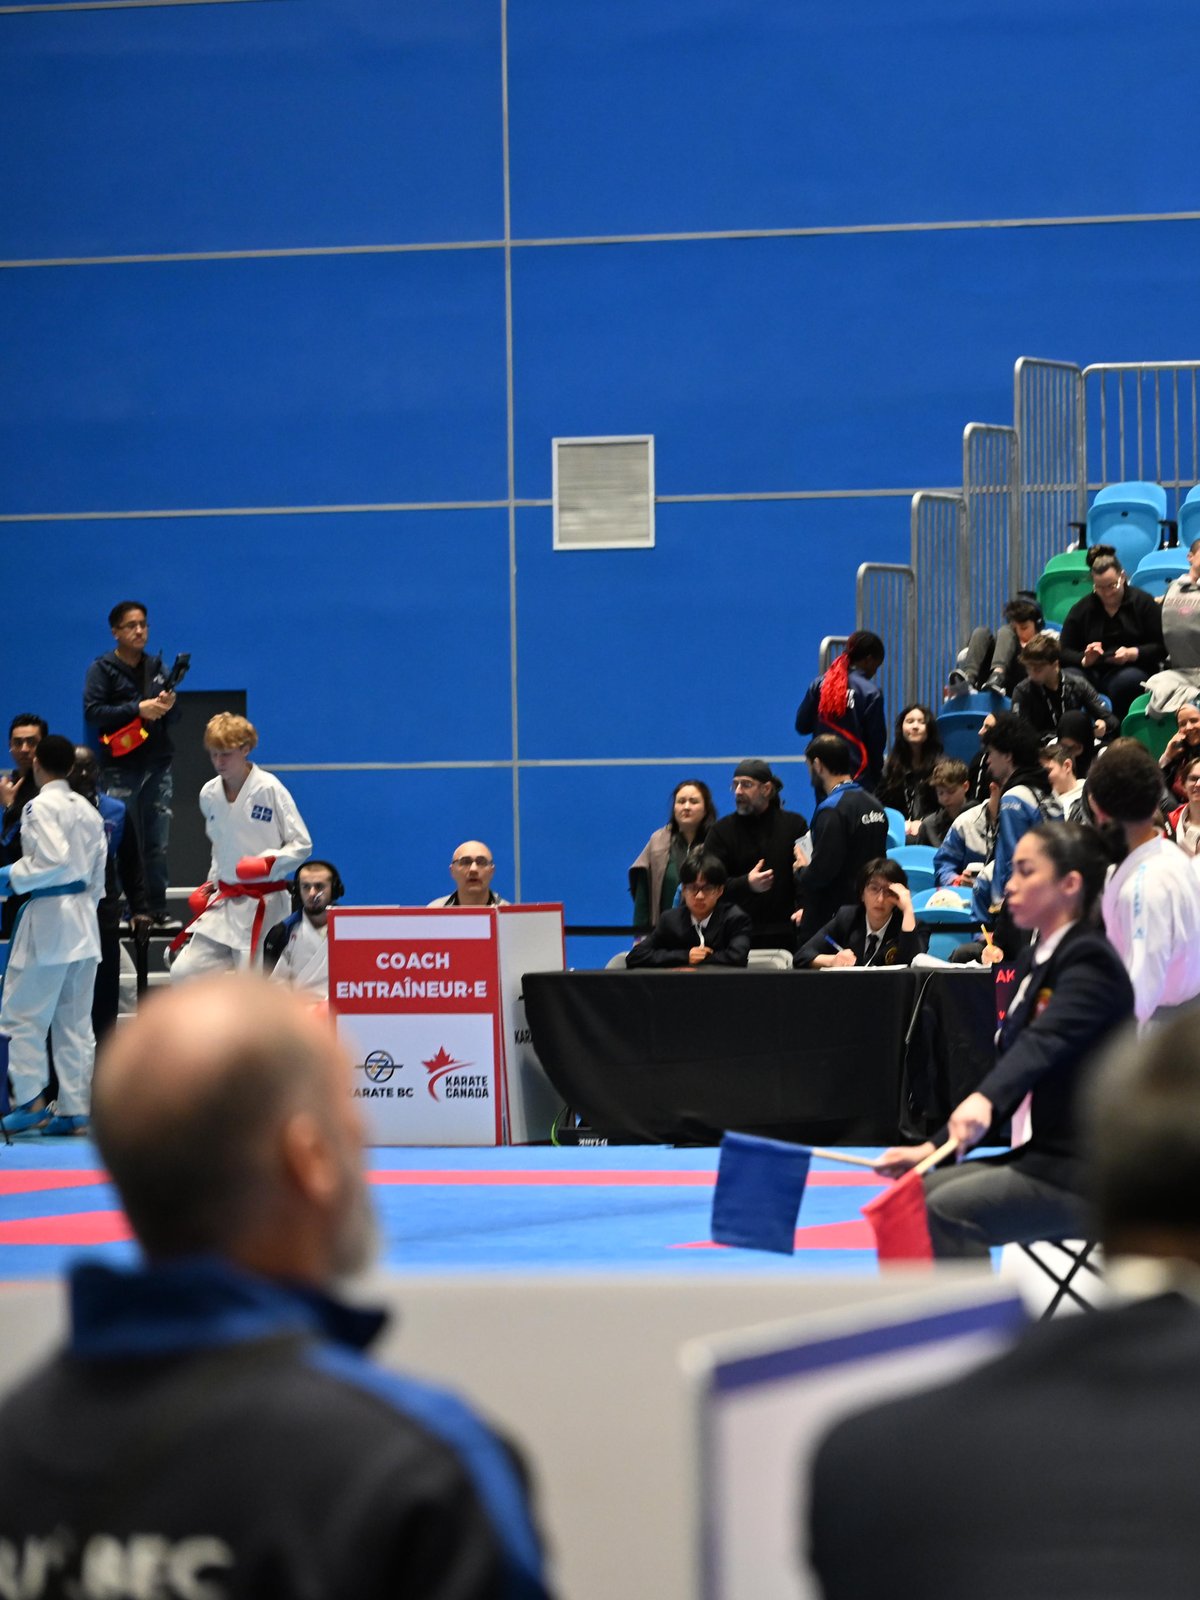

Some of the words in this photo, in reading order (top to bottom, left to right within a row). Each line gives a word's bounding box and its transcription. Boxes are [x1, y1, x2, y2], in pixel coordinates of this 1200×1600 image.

[376, 952, 450, 970] COACH
[996, 968, 1015, 983] AK
[514, 1030, 533, 1045] KAR
[445, 1075, 488, 1087] KARATE
[350, 1087, 394, 1098] ARATE
[397, 1087, 414, 1098] BC
[445, 1088, 490, 1099] CANADA
